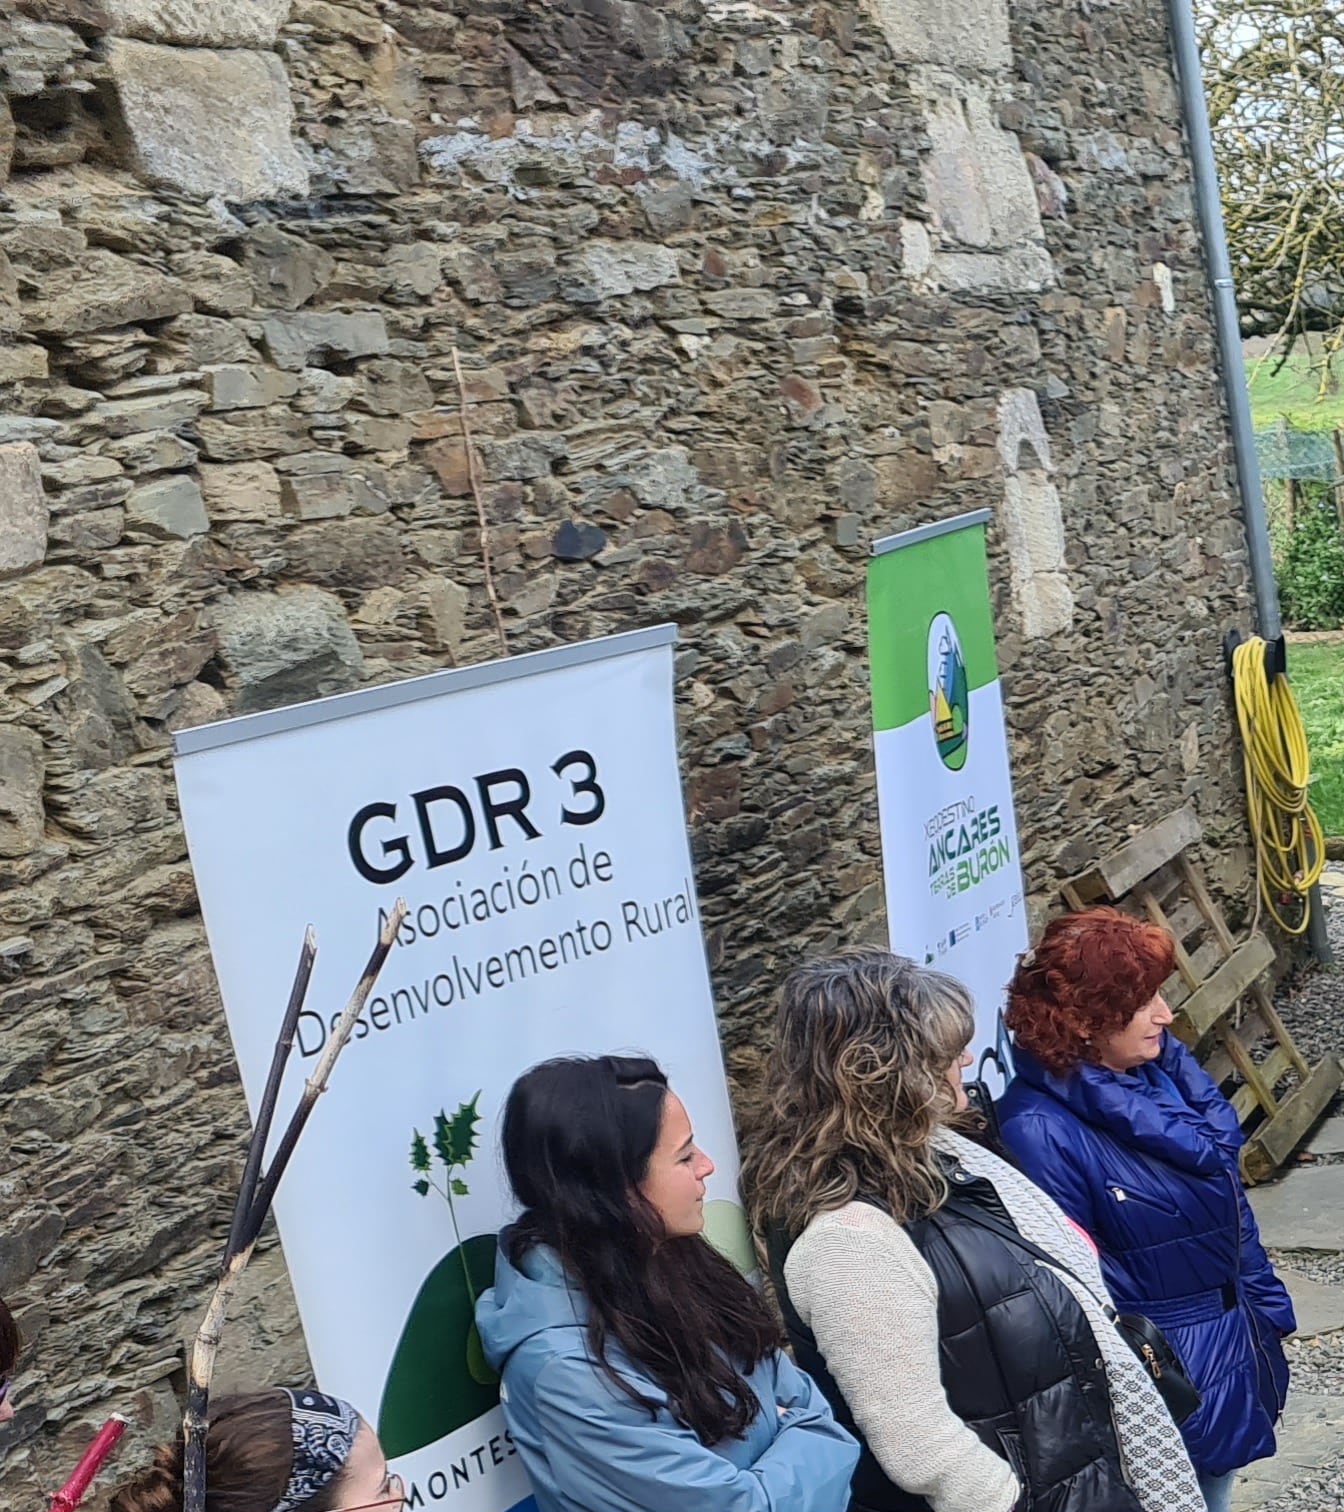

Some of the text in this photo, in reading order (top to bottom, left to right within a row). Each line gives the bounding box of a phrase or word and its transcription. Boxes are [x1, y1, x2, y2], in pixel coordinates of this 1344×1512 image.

[347, 750, 606, 885] GDR 3
[929, 805, 1001, 877] ANCARES
[568, 843, 614, 888] de
[956, 835, 1010, 893] BURÓN
[621, 877, 694, 942] Rural
